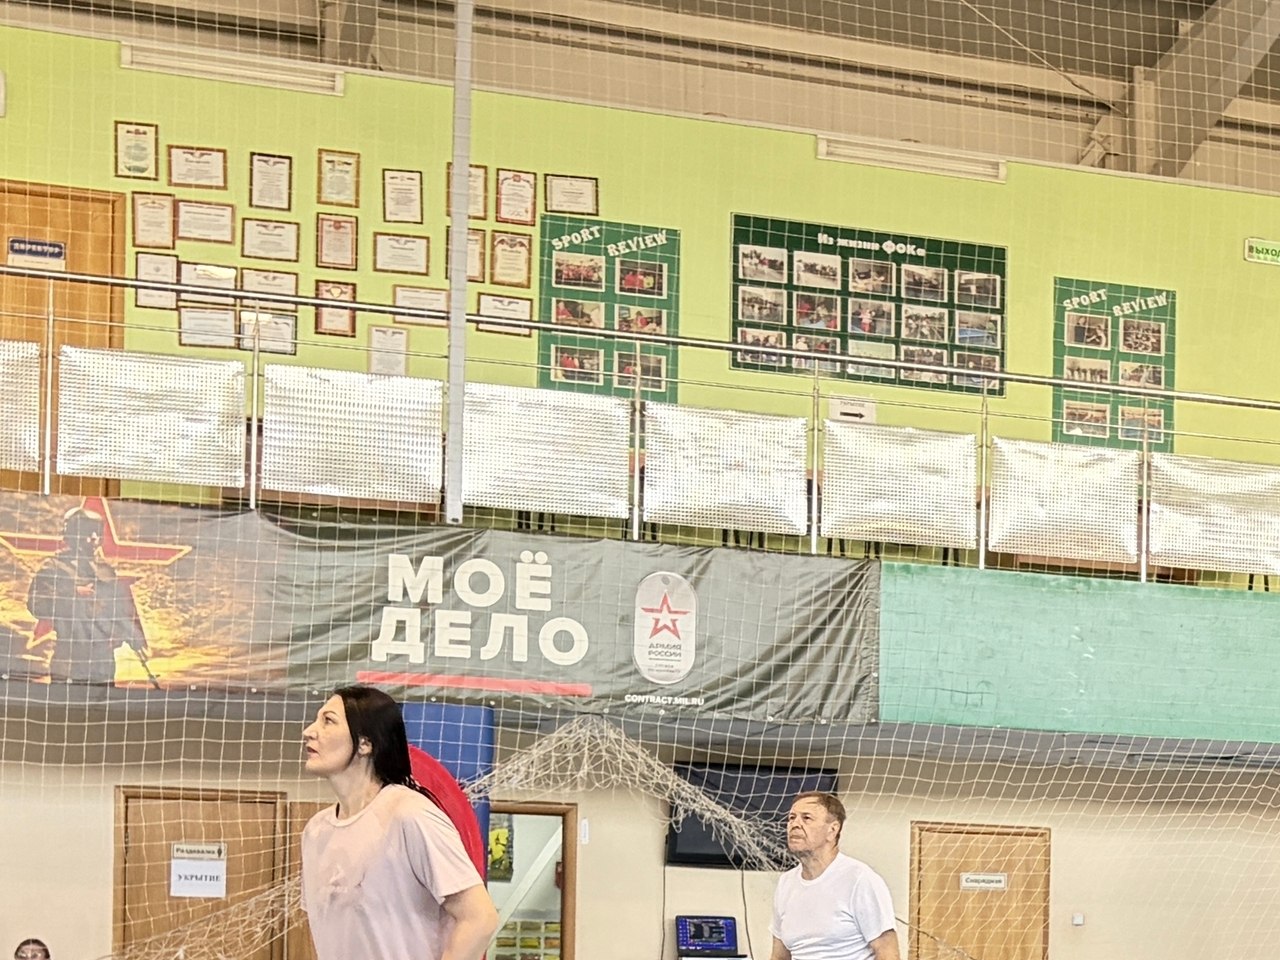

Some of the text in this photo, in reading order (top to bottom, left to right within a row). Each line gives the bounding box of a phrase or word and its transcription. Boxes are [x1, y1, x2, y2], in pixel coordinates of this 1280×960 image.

[13, 242, 61, 254] ДИРЕКТОР
[551, 226, 668, 256] SPORT REVIEW
[817, 232, 834, 245] Из
[1063, 288, 1168, 316] SPORT REVIEW
[388, 550, 552, 611] МОЁ
[371, 606, 589, 666] ДЕЛО
[624, 694, 705, 706] CONTRACT.MIL.RU
[177, 873, 220, 882] УКРЫТИЕ
